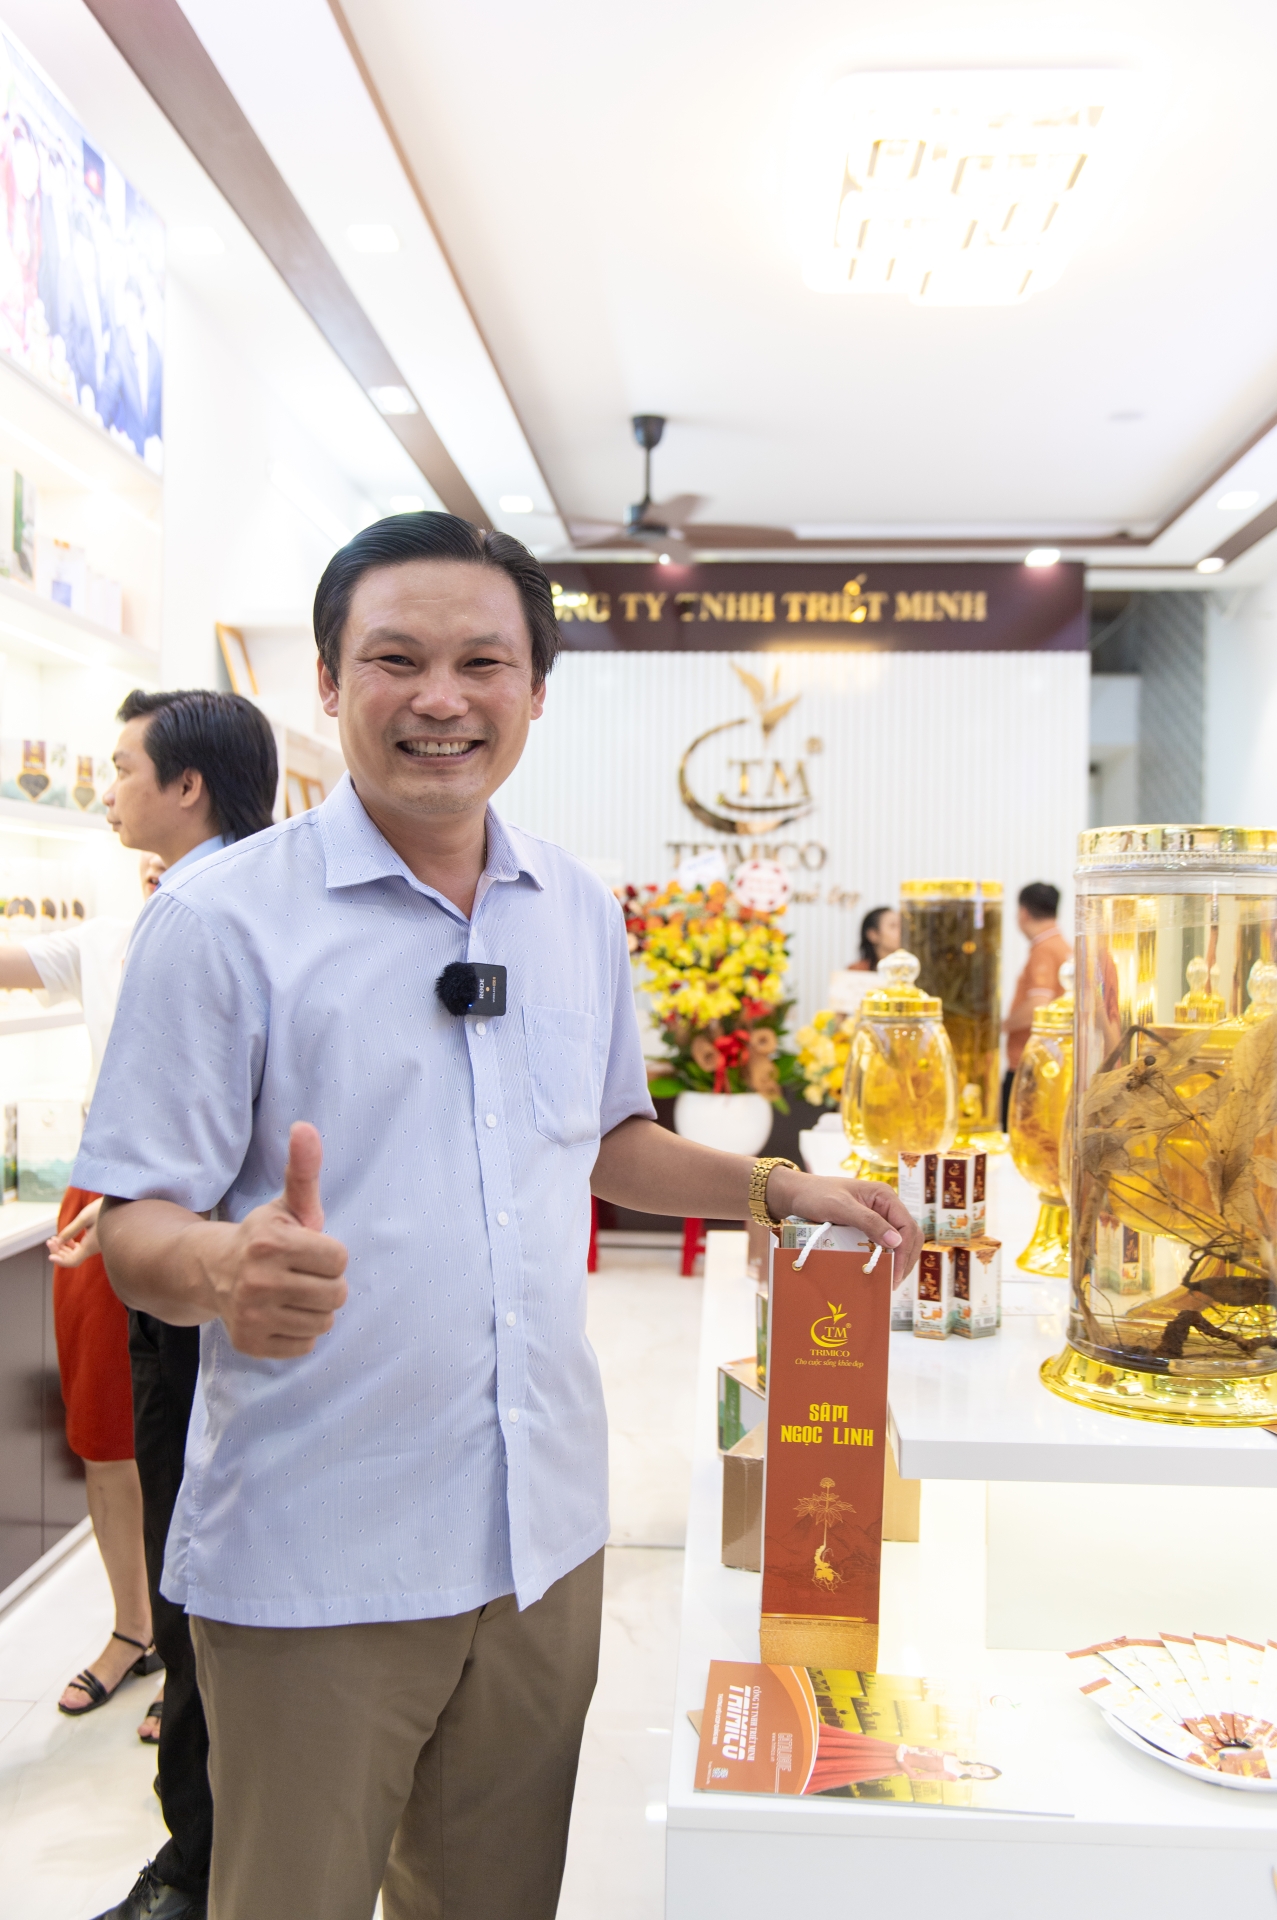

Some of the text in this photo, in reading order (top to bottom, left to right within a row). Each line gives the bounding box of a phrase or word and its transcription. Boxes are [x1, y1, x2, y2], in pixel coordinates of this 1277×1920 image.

[617, 591, 668, 622] TY
[674, 591, 776, 622] TNHH
[781, 573, 889, 623] TRIẾT
[894, 591, 987, 622] MINH
[728, 759, 811, 798] TM
[824, 1326, 848, 1338] TM
[809, 1349, 850, 1357] TRIMICO
[823, 1359, 837, 1368] sống
[809, 1402, 849, 1422] SÂM
[780, 1425, 874, 1447] NGỌC LINH
[722, 1685, 751, 1761] TRIMICO
[747, 1685, 762, 1761] CÔNG TY TNHH TRIẾT MINH
